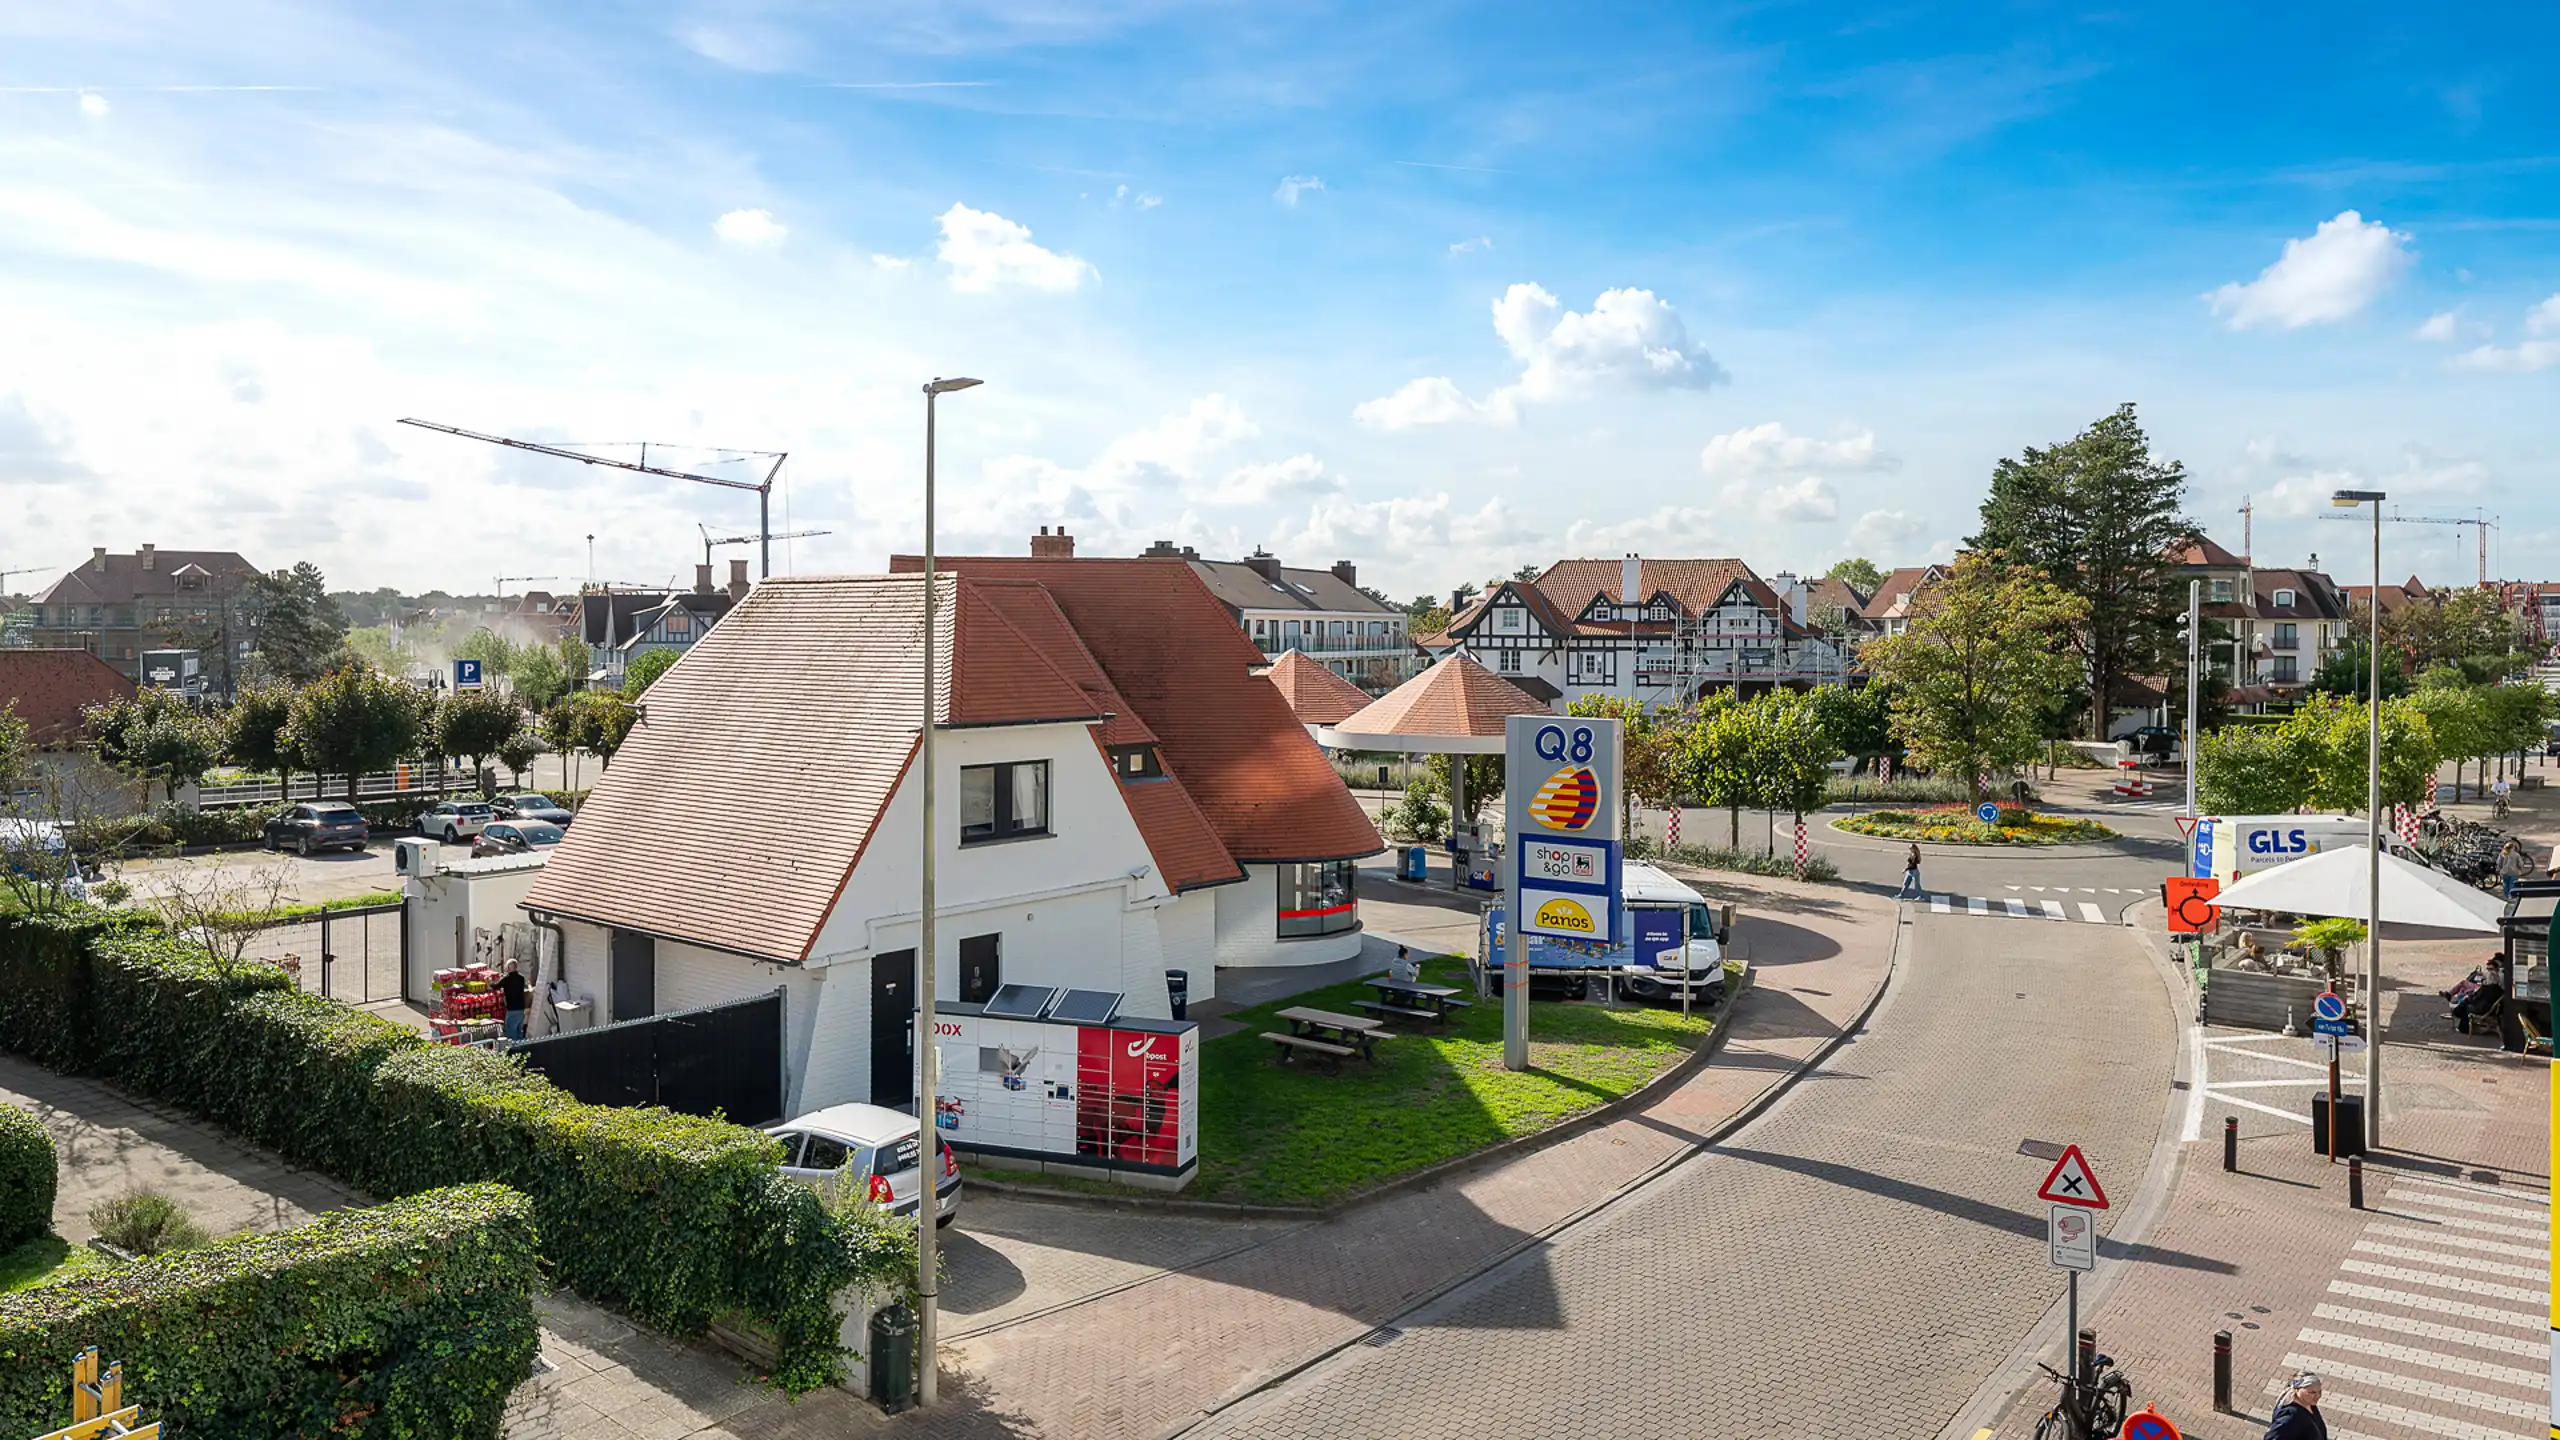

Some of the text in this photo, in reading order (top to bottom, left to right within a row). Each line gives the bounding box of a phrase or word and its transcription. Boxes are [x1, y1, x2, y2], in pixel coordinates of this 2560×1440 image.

[464, 663, 475, 677] P
[1535, 724, 1595, 763] Q8
[2248, 829, 2307, 854] GLS
[1537, 846, 1570, 864] shop
[1543, 861, 1570, 876] &go
[1541, 912, 1588, 928] Panos
[1146, 1051, 1167, 1061] bpost
